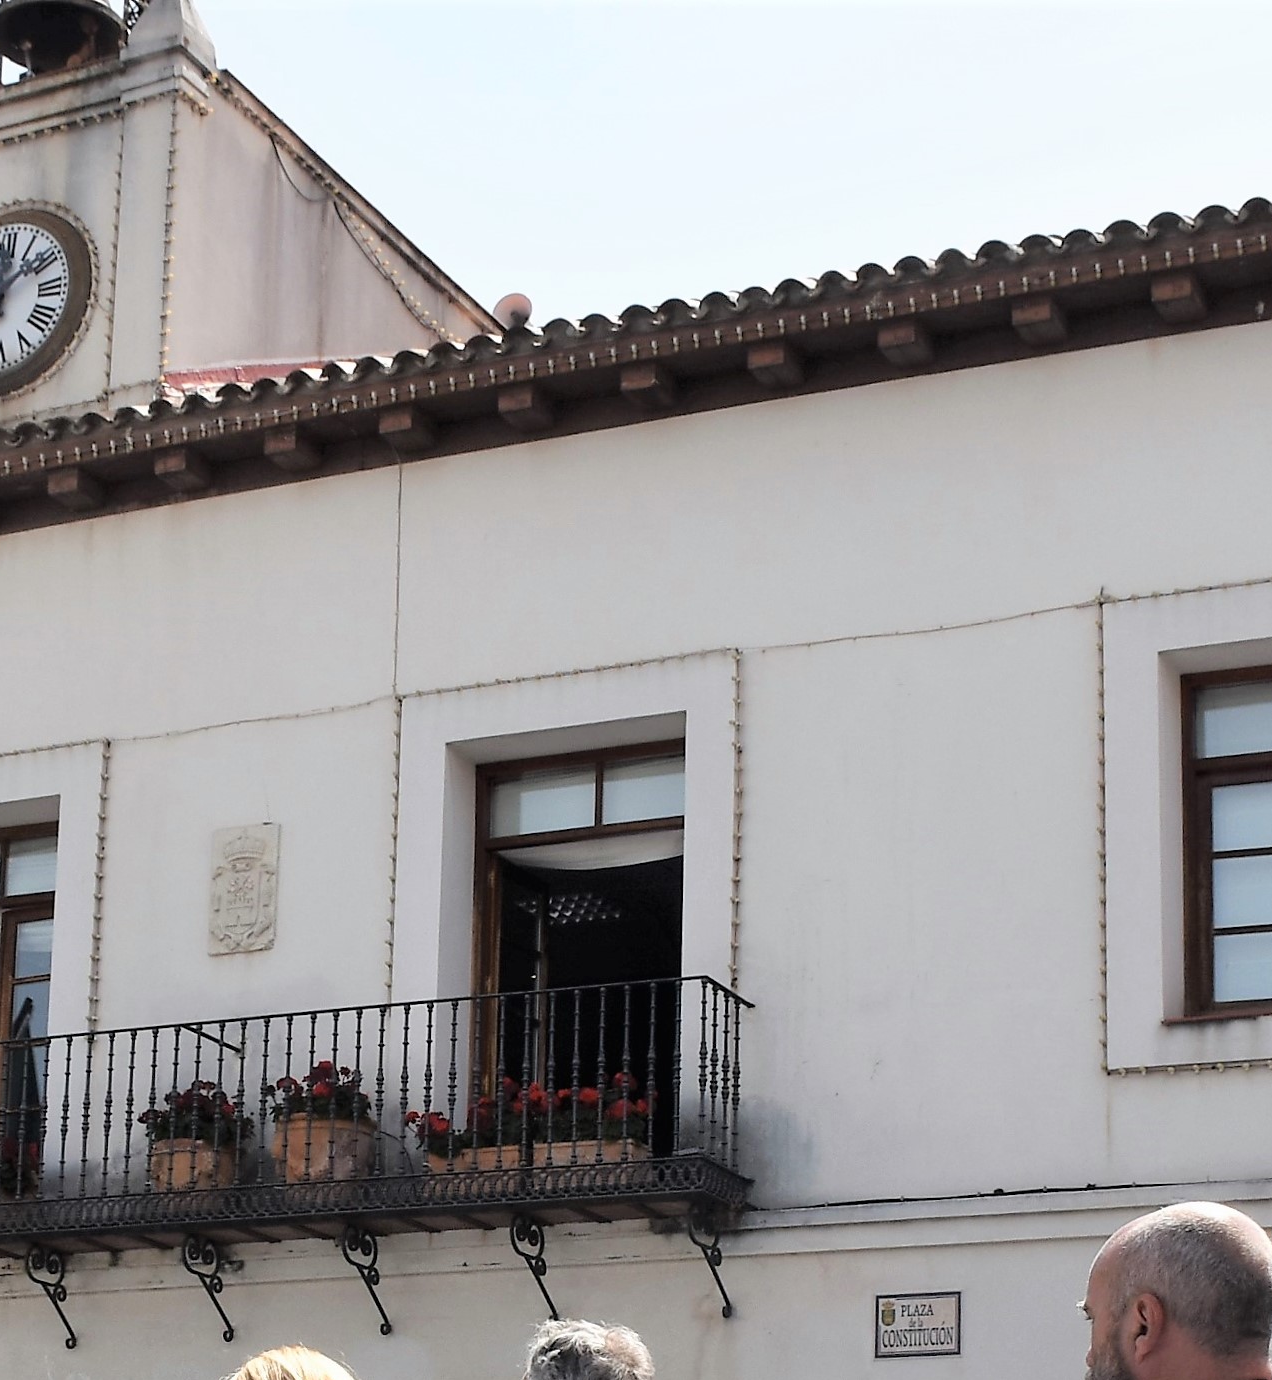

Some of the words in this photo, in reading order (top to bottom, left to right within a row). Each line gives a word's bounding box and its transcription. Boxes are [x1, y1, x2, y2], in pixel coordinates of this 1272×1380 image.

[22, 235, 37, 261] I
[37, 276, 62, 297] III
[27, 303, 56, 333] IIII
[16, 329, 32, 354] V
[900, 1304, 934, 1317] PLAZA
[909, 1317, 916, 1327] de
[918, 1317, 923, 1327] la
[882, 1320, 954, 1348] CONSTITUCIÓN
